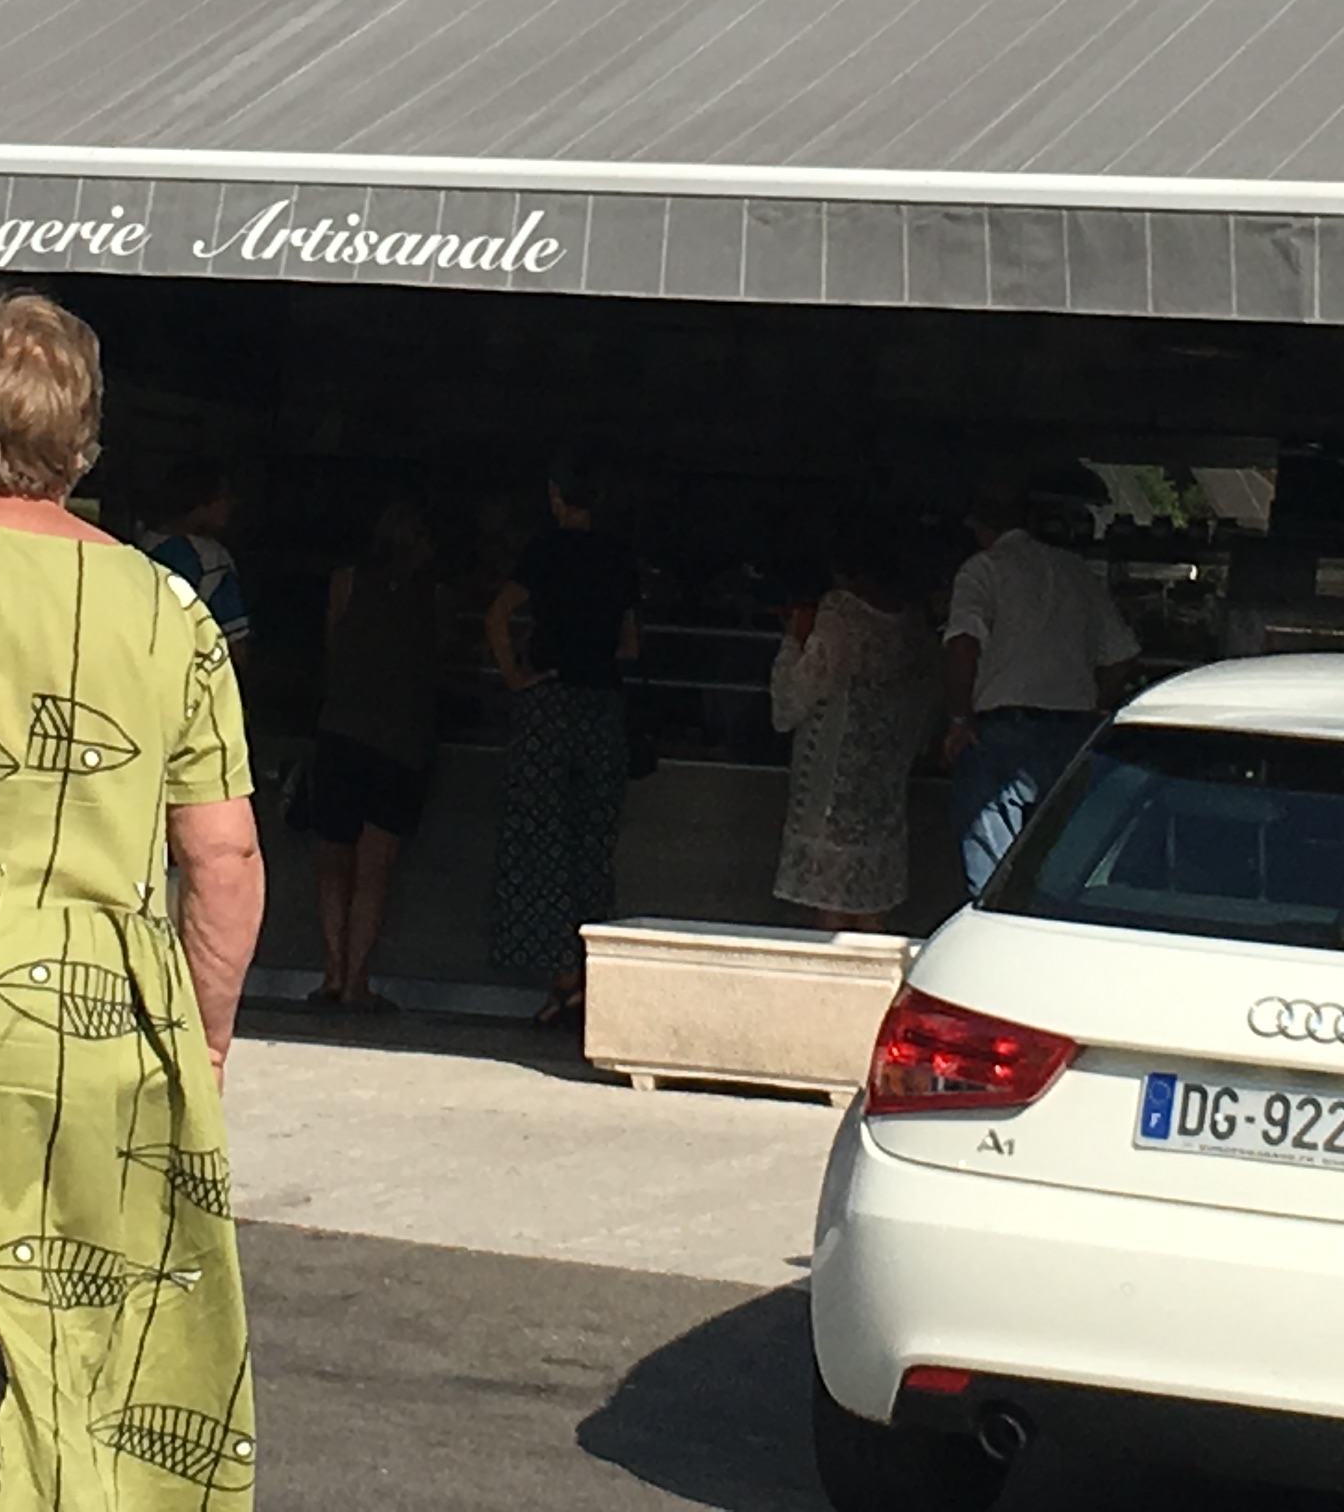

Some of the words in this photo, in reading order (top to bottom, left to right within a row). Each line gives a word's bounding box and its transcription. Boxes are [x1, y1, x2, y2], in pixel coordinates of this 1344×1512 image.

[192, 192, 568, 274] Artisanale
[1149, 1112, 1162, 1129] F
[976, 1128, 1016, 1156] A1
